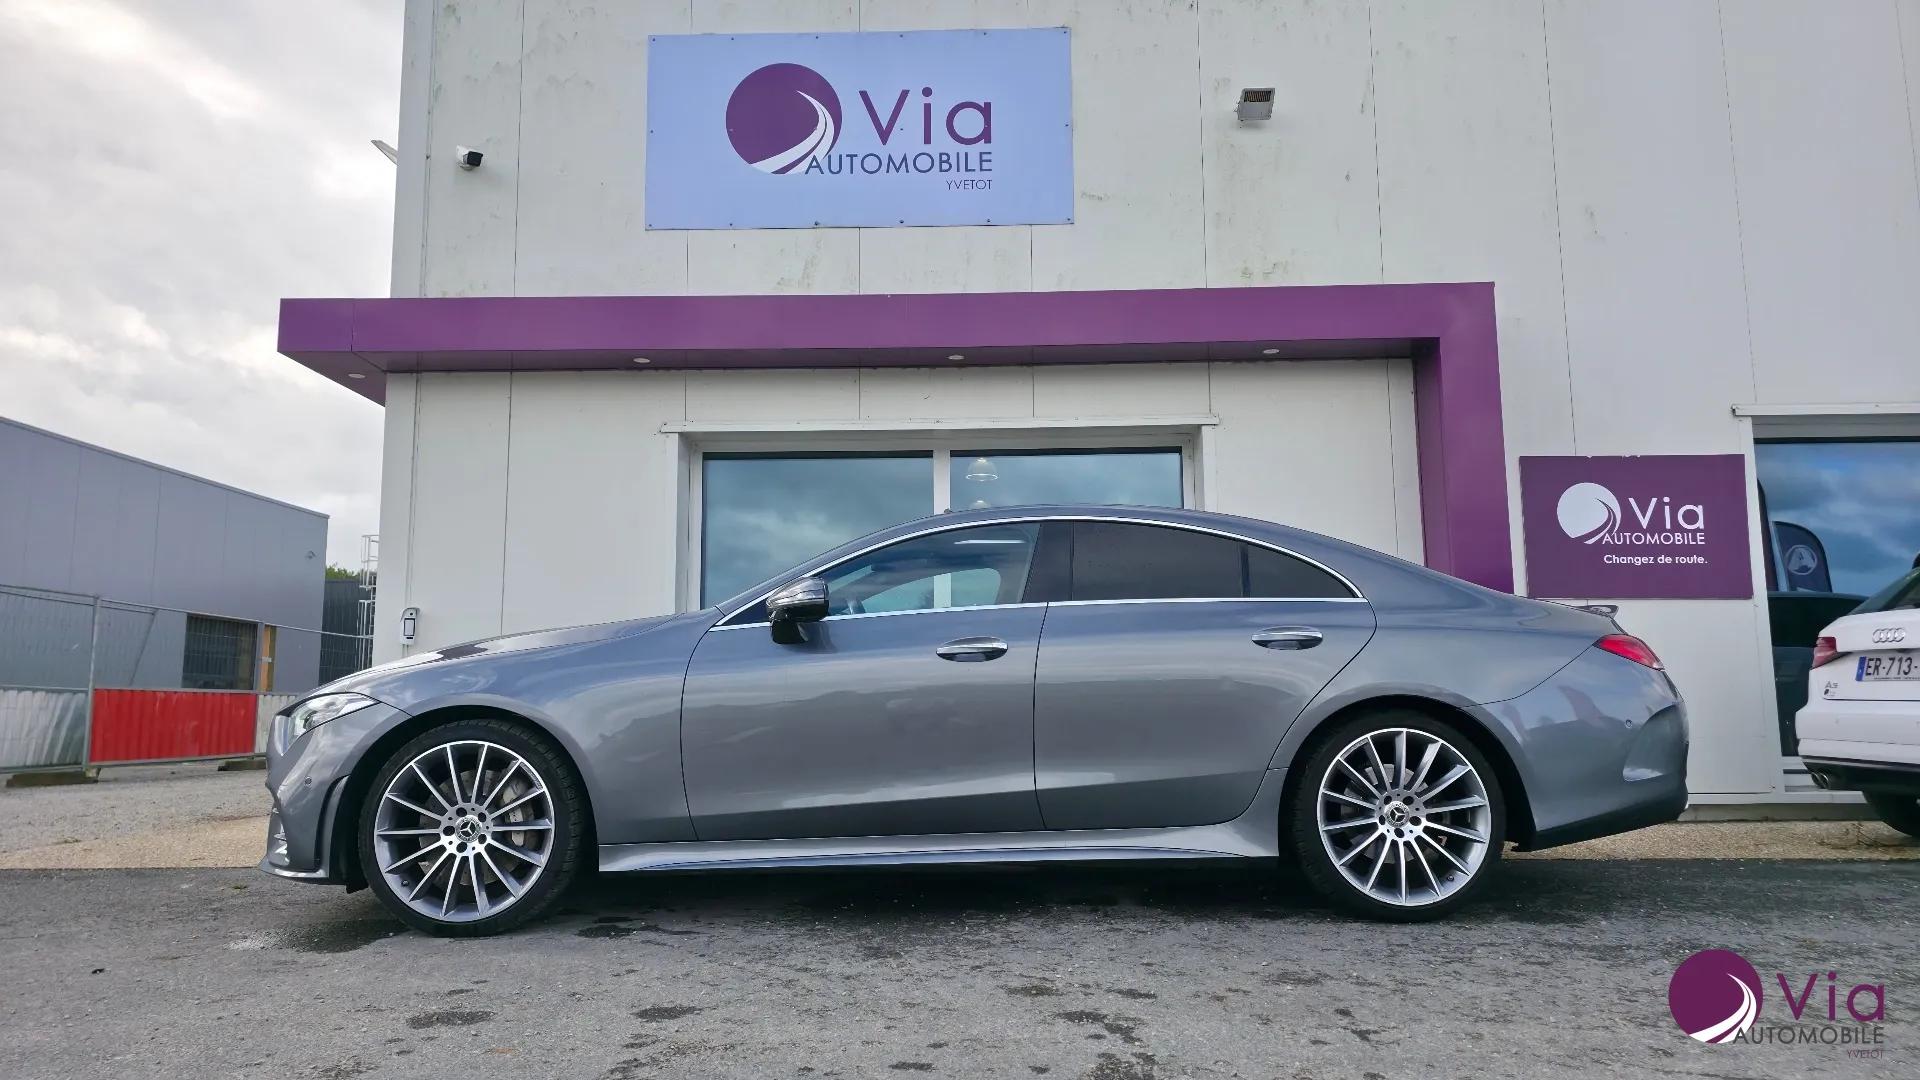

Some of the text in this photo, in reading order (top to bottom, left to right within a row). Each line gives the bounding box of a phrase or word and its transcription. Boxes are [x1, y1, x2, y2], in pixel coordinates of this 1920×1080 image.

[859, 87, 992, 146] Via
[805, 151, 993, 175] AUTOMOBILE
[945, 179, 993, 190] YVETOT
[1628, 497, 1705, 530] Via
[1602, 532, 1706, 545] AUTOMOBILE
[1603, 554, 1708, 566] Changez de route.
